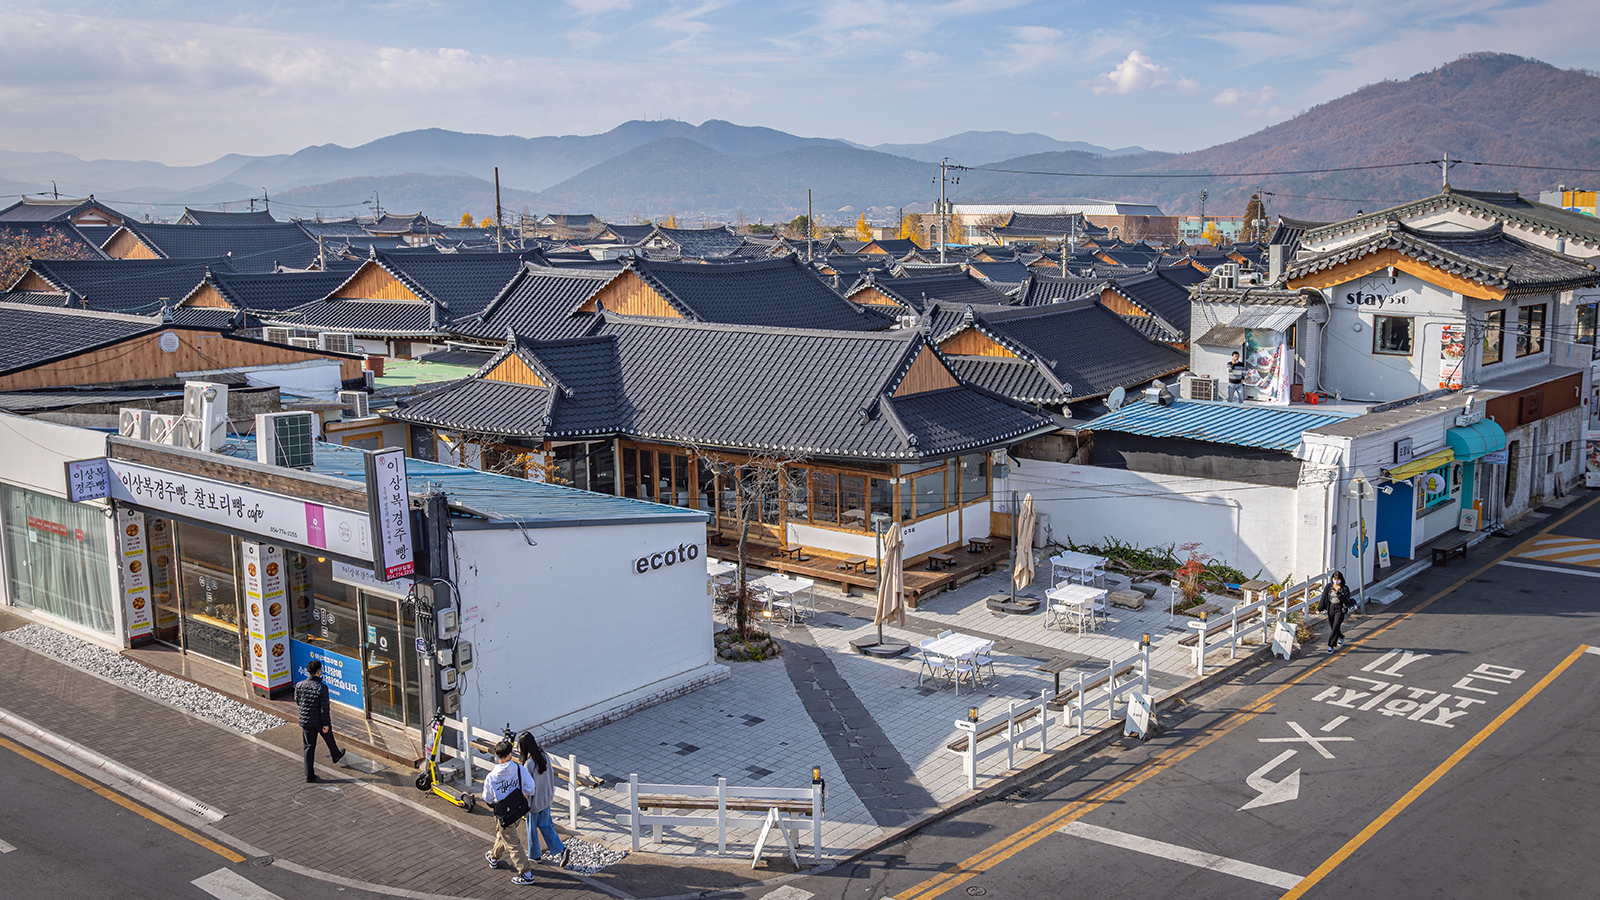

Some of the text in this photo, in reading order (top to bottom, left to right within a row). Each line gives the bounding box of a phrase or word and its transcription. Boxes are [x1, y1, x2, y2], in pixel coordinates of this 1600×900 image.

[73, 467, 106, 481] 이상복
[74, 479, 108, 494] 경주빵
[122, 471, 264, 523] 이상복경주빵_찰보리빵 cafe
[387, 457, 409, 560] 이상복경주빵
[636, 543, 699, 574] ecoto
[1311, 676, 1487, 729] 좌회전
